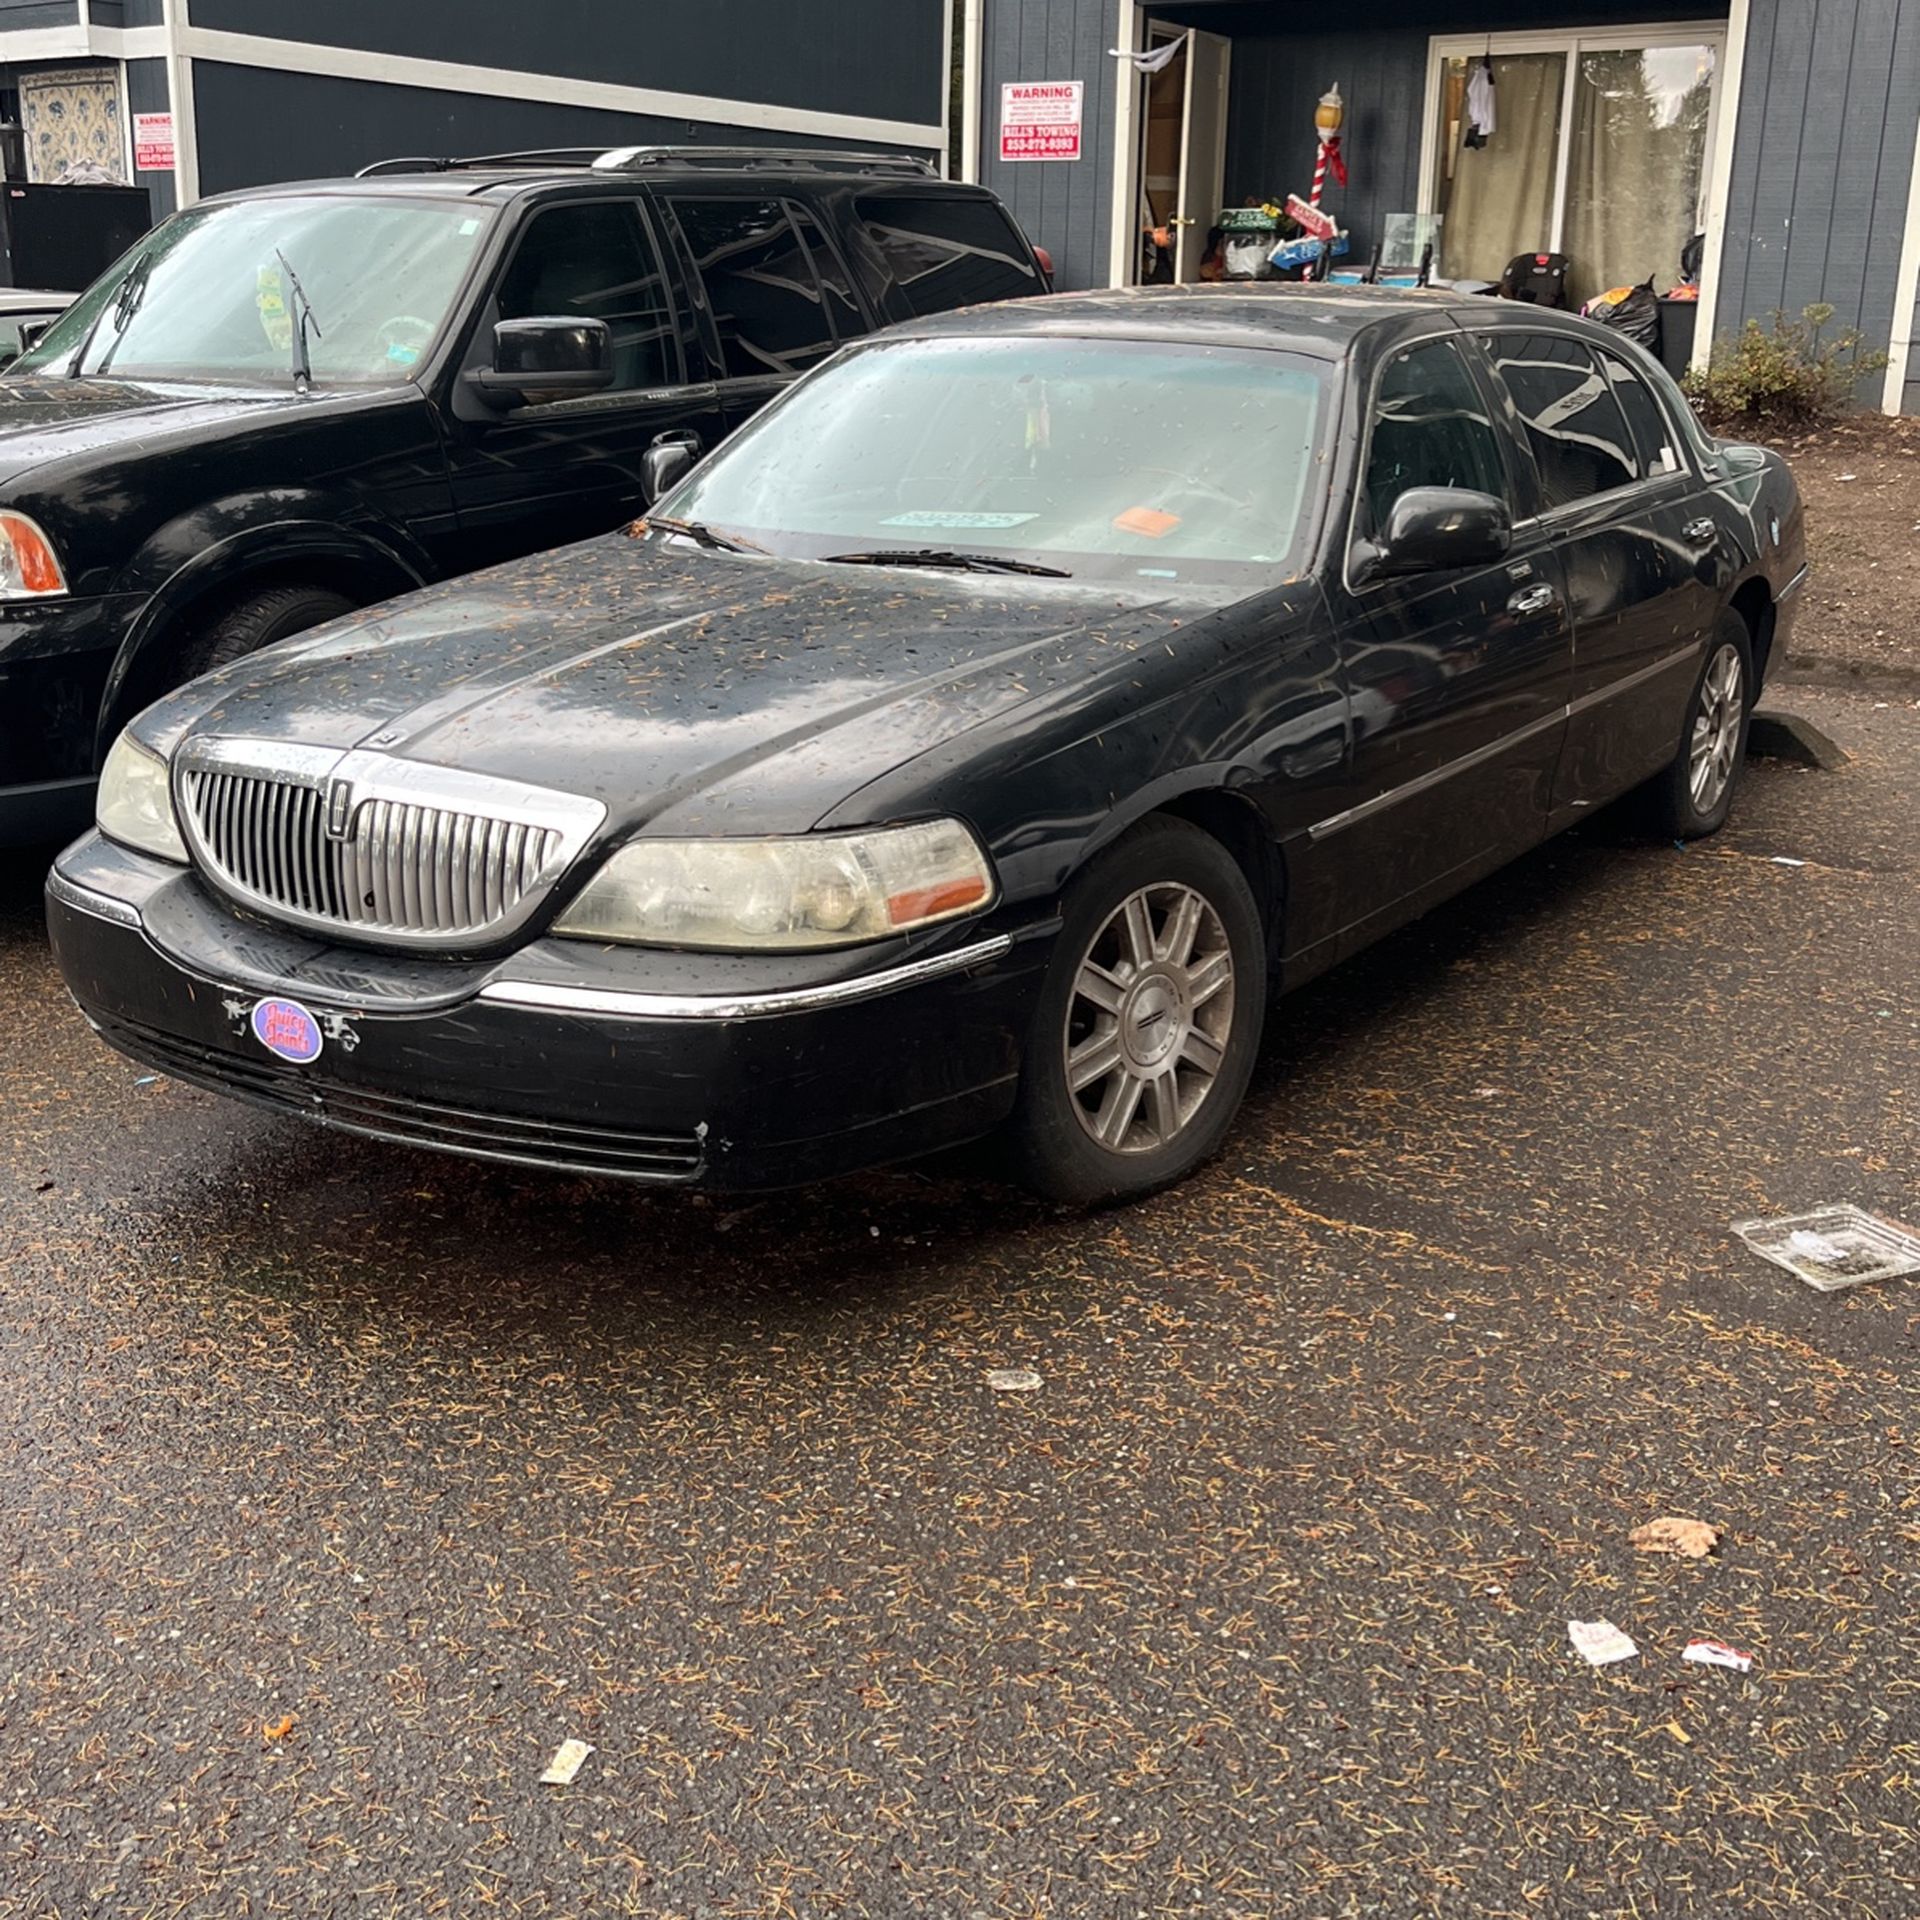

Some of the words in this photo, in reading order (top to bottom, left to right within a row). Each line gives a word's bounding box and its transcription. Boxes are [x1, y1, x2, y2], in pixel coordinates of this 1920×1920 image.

[1012, 86, 1073, 98] WARNING
[1004, 126, 1035, 137] BILL'S
[1036, 125, 1078, 137] TOWING
[266, 1003, 306, 1035] Juicy
